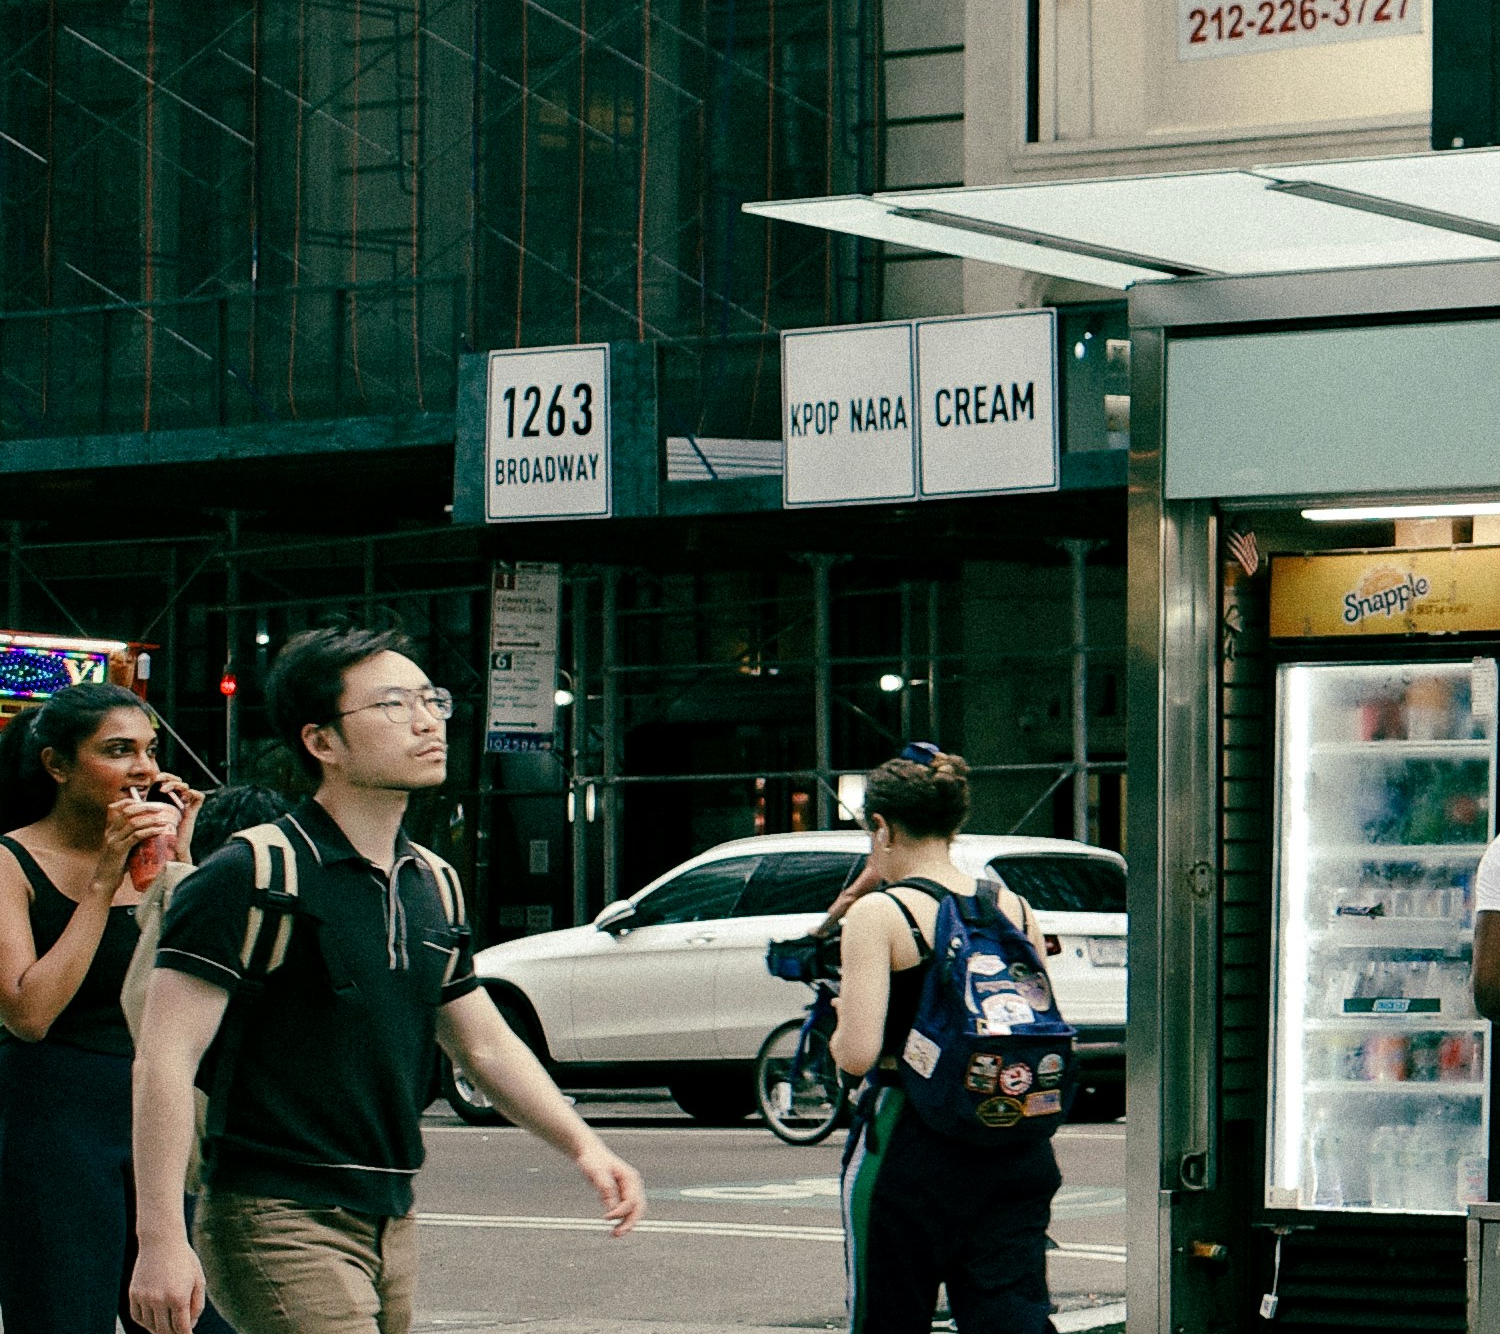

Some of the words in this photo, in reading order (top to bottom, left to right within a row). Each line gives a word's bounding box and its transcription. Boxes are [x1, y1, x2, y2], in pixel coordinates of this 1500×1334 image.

[503, 383, 593, 438] 1263
[790, 398, 840, 437] KPOP
[851, 394, 908, 433] NARA
[935, 382, 1035, 427] CREAM
[495, 453, 599, 486] BROADWAY
[1343, 575, 1428, 623] Snapple
